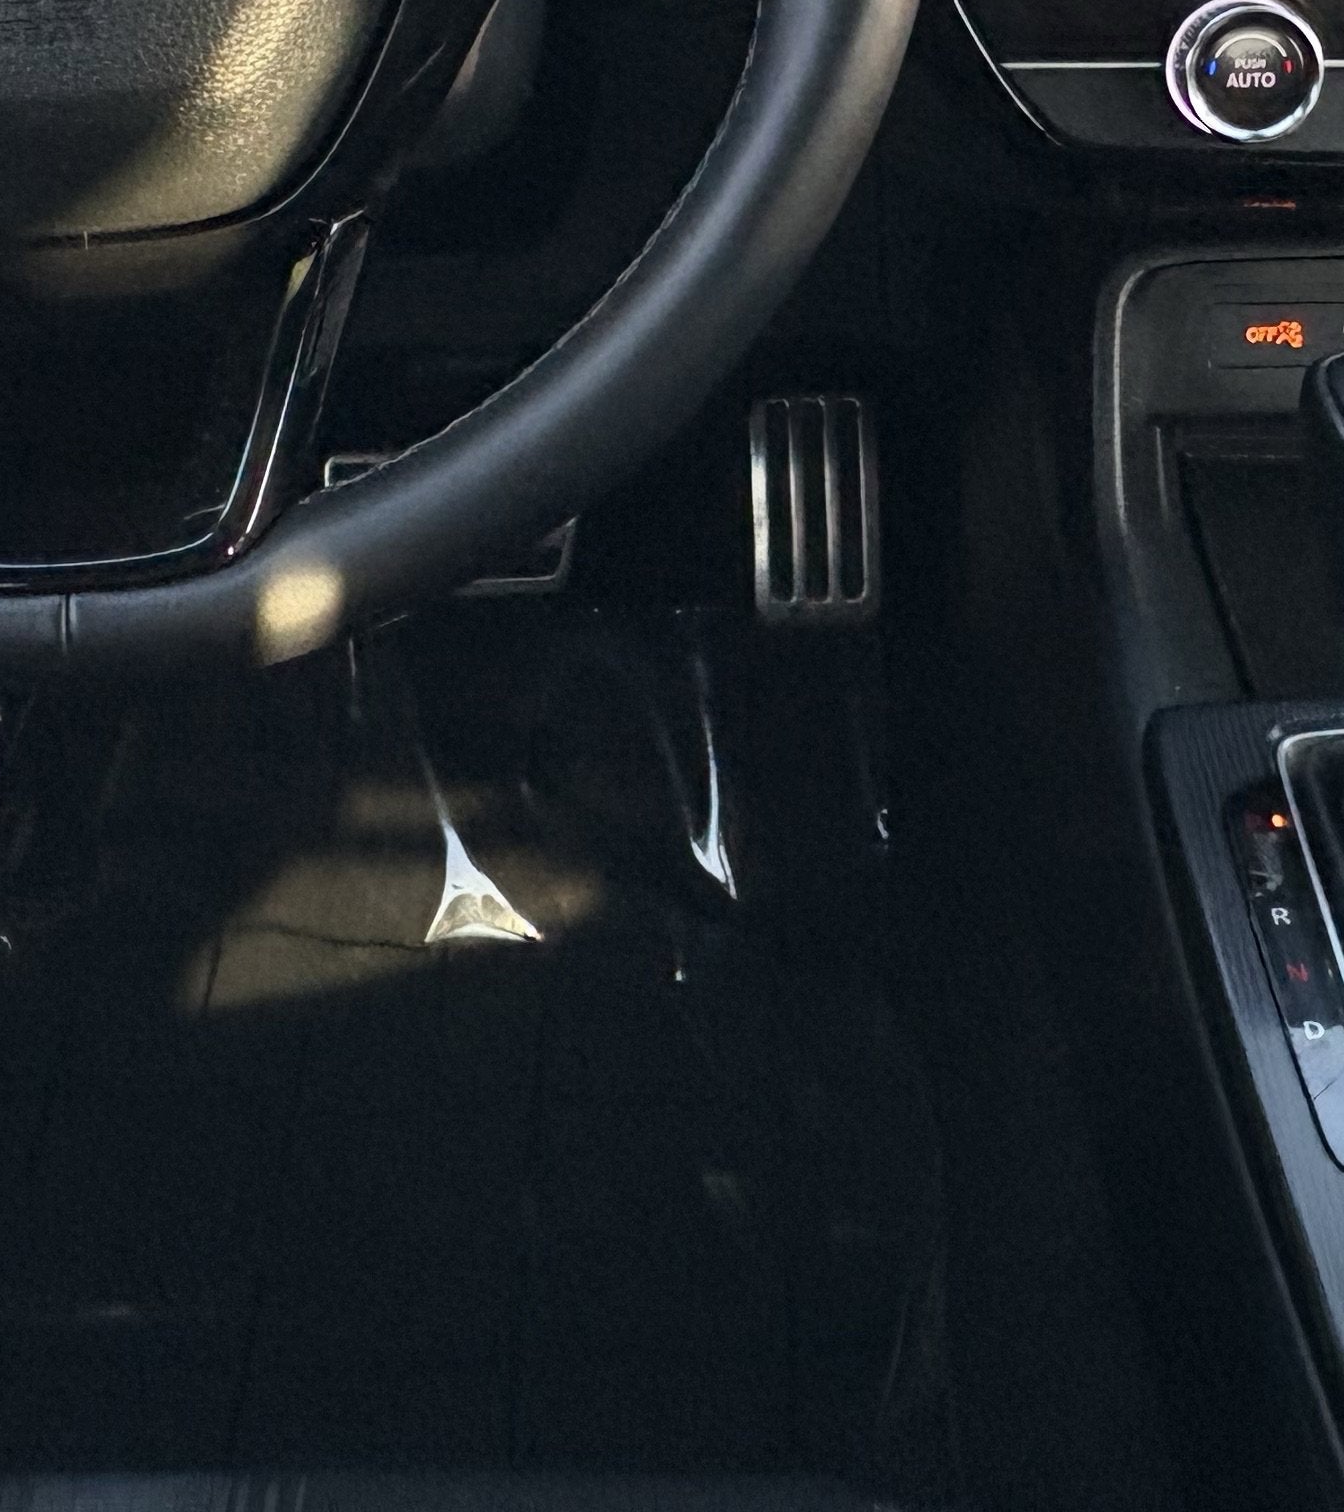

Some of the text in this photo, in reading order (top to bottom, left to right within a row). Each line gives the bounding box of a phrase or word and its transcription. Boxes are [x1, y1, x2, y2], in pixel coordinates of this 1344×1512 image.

[1226, 71, 1276, 88] AUTO
[1271, 907, 1291, 926] R
[1285, 961, 1309, 983] N
[1304, 1020, 1325, 1040] D
